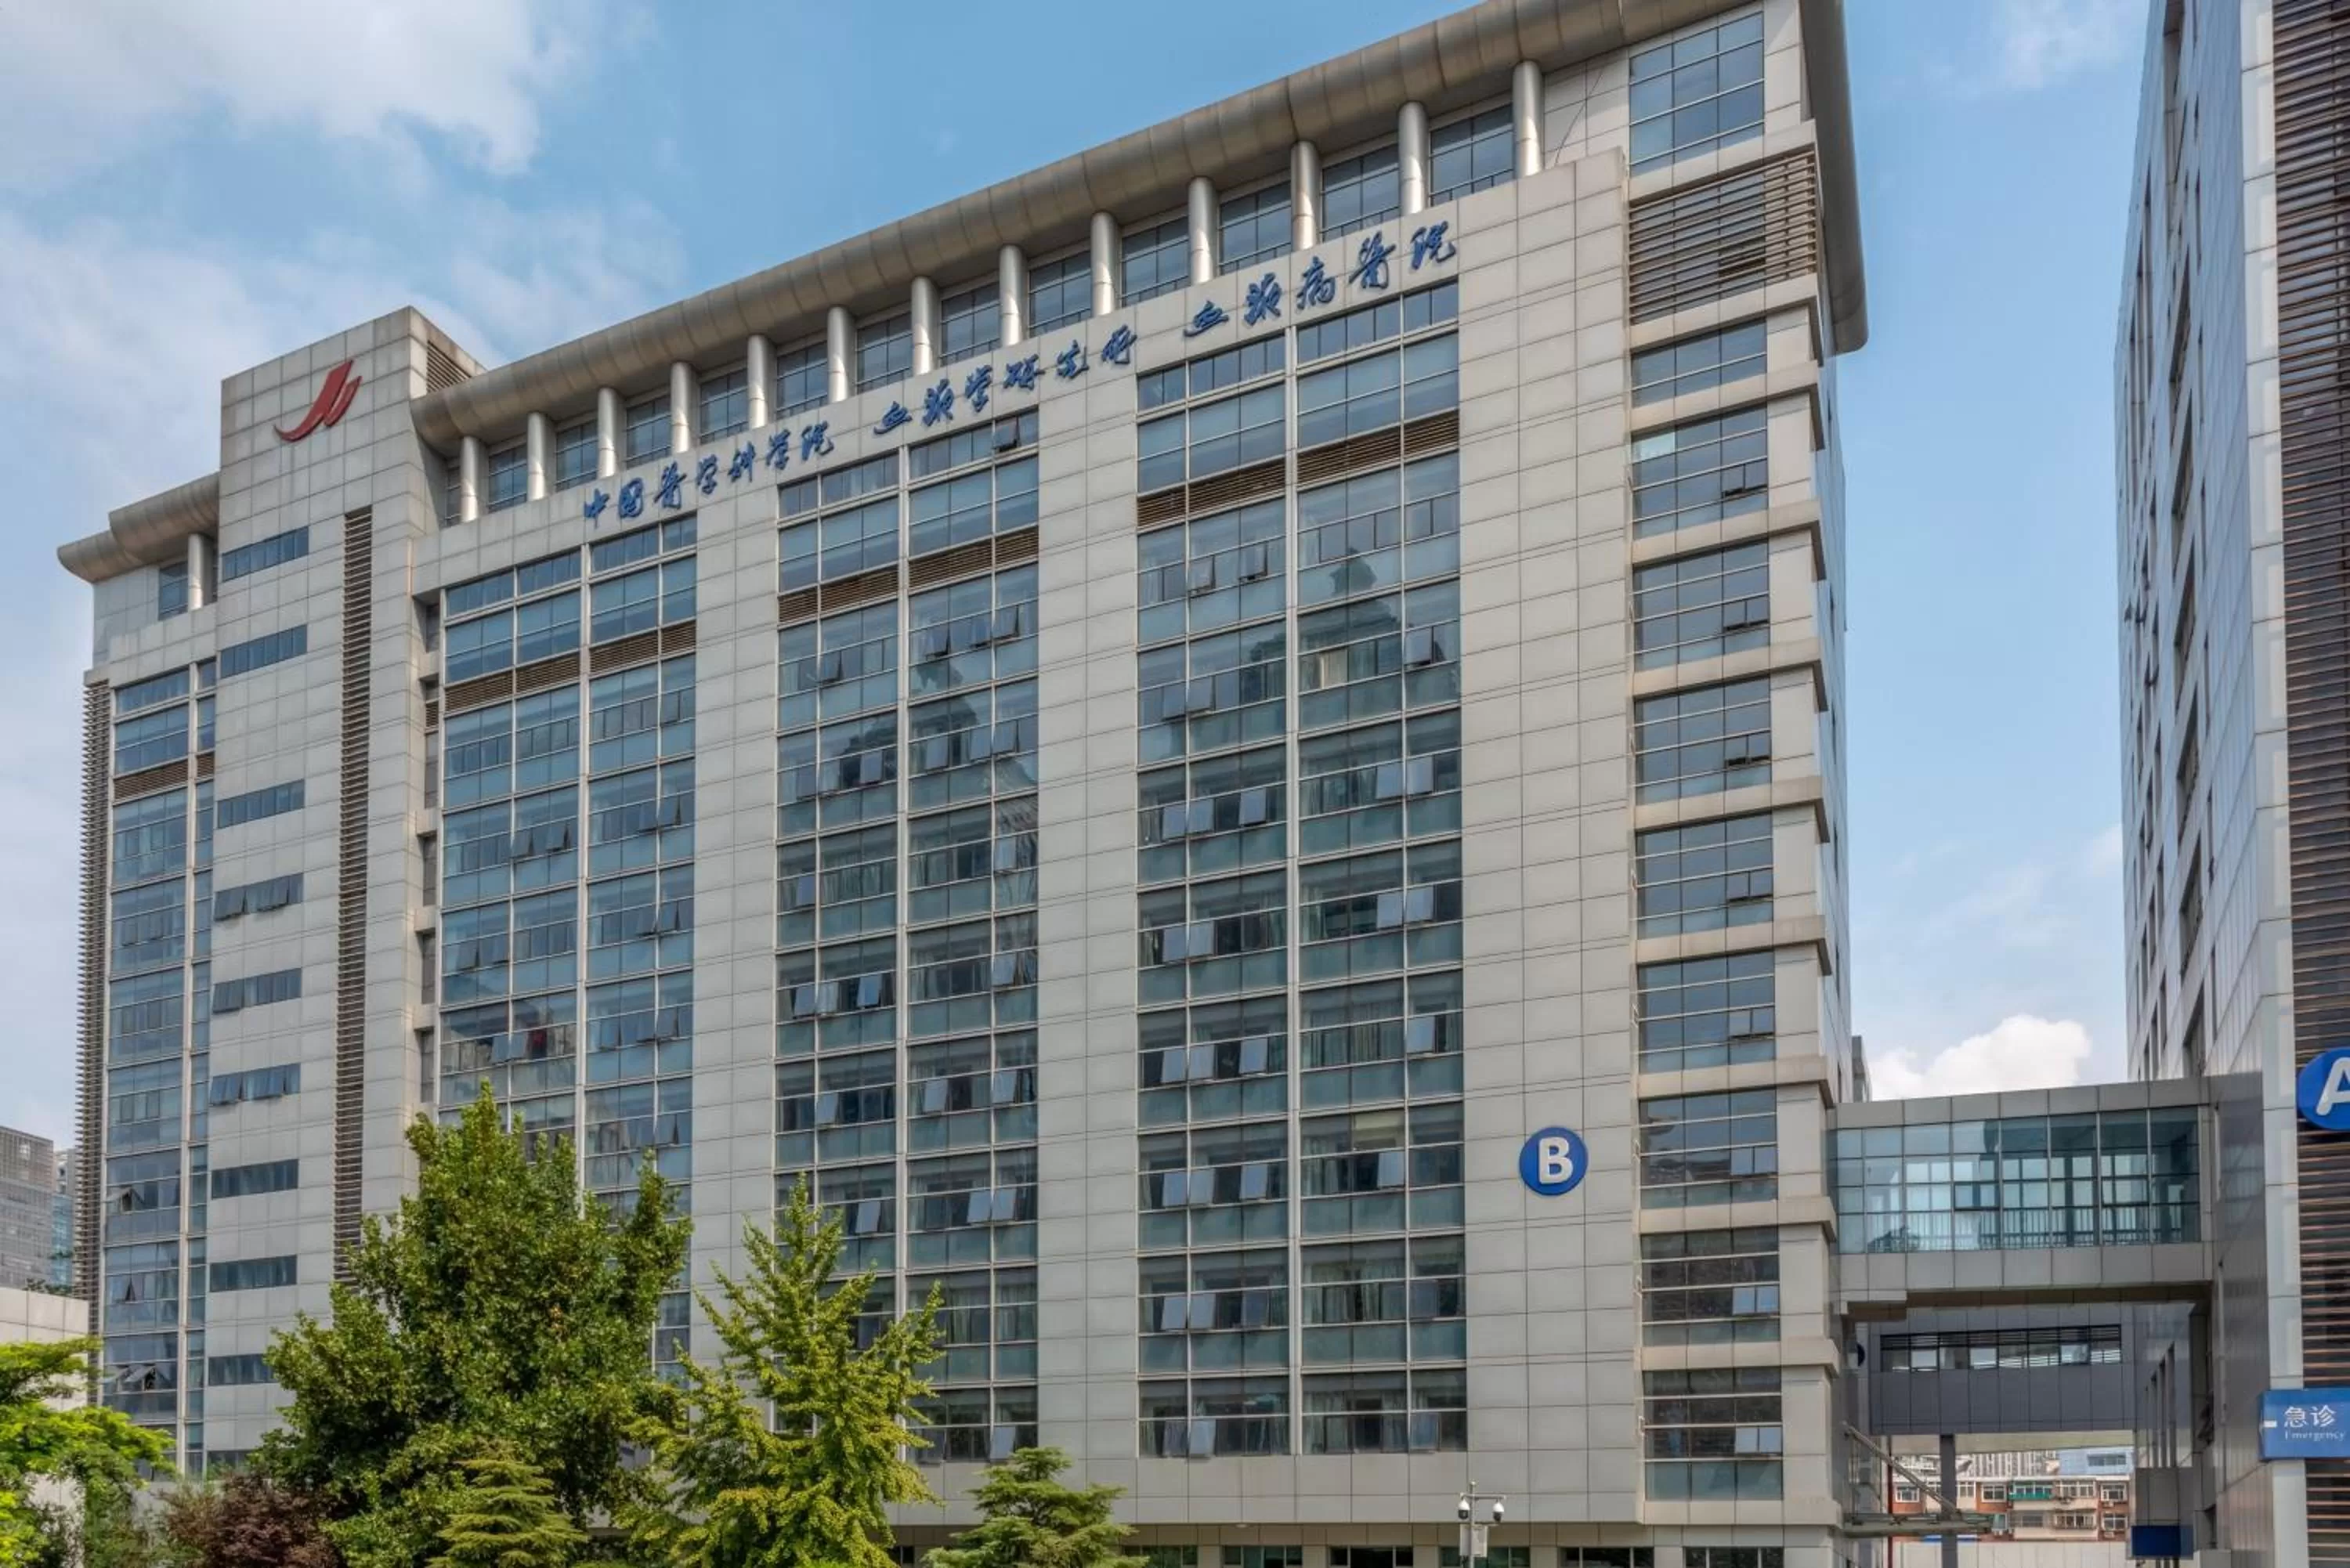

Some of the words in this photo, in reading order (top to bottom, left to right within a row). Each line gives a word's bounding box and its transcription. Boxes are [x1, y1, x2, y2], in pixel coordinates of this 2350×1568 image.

[2316, 1057, 2350, 1115] A
[1538, 1136, 1573, 1184] B
[2283, 1404, 2336, 1428] 急诊
